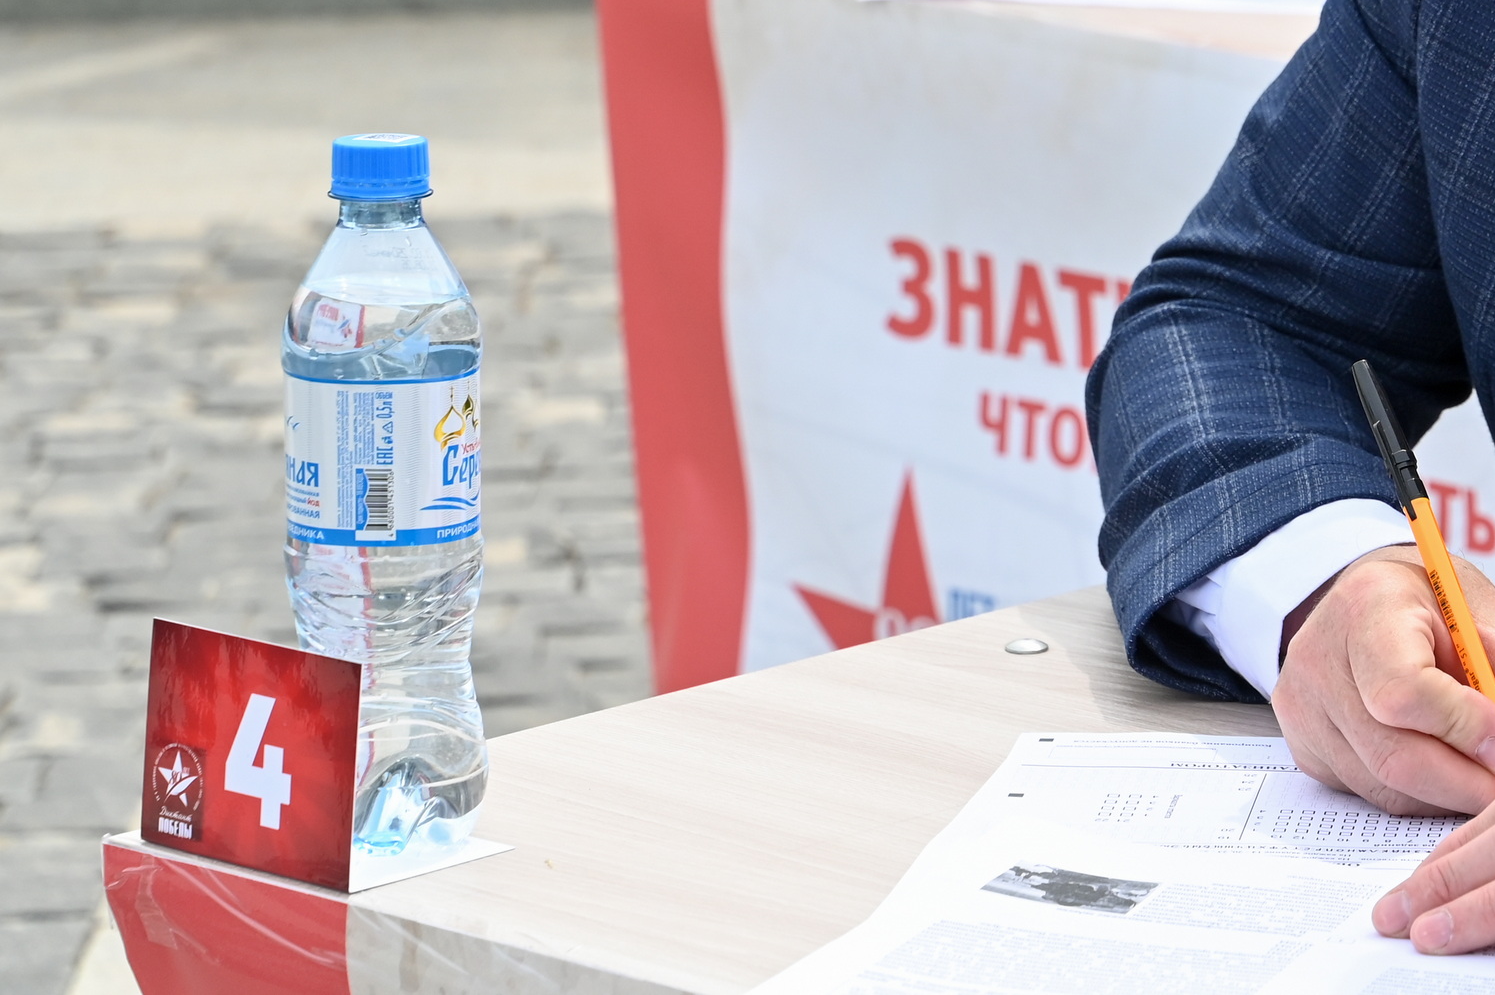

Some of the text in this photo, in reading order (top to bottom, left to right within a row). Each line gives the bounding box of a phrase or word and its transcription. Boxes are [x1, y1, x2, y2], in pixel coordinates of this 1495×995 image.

[977, 390, 1092, 470] ЧТО
[224, 693, 292, 830] 4
[158, 817, 193, 839] ПОБЕДЫ
